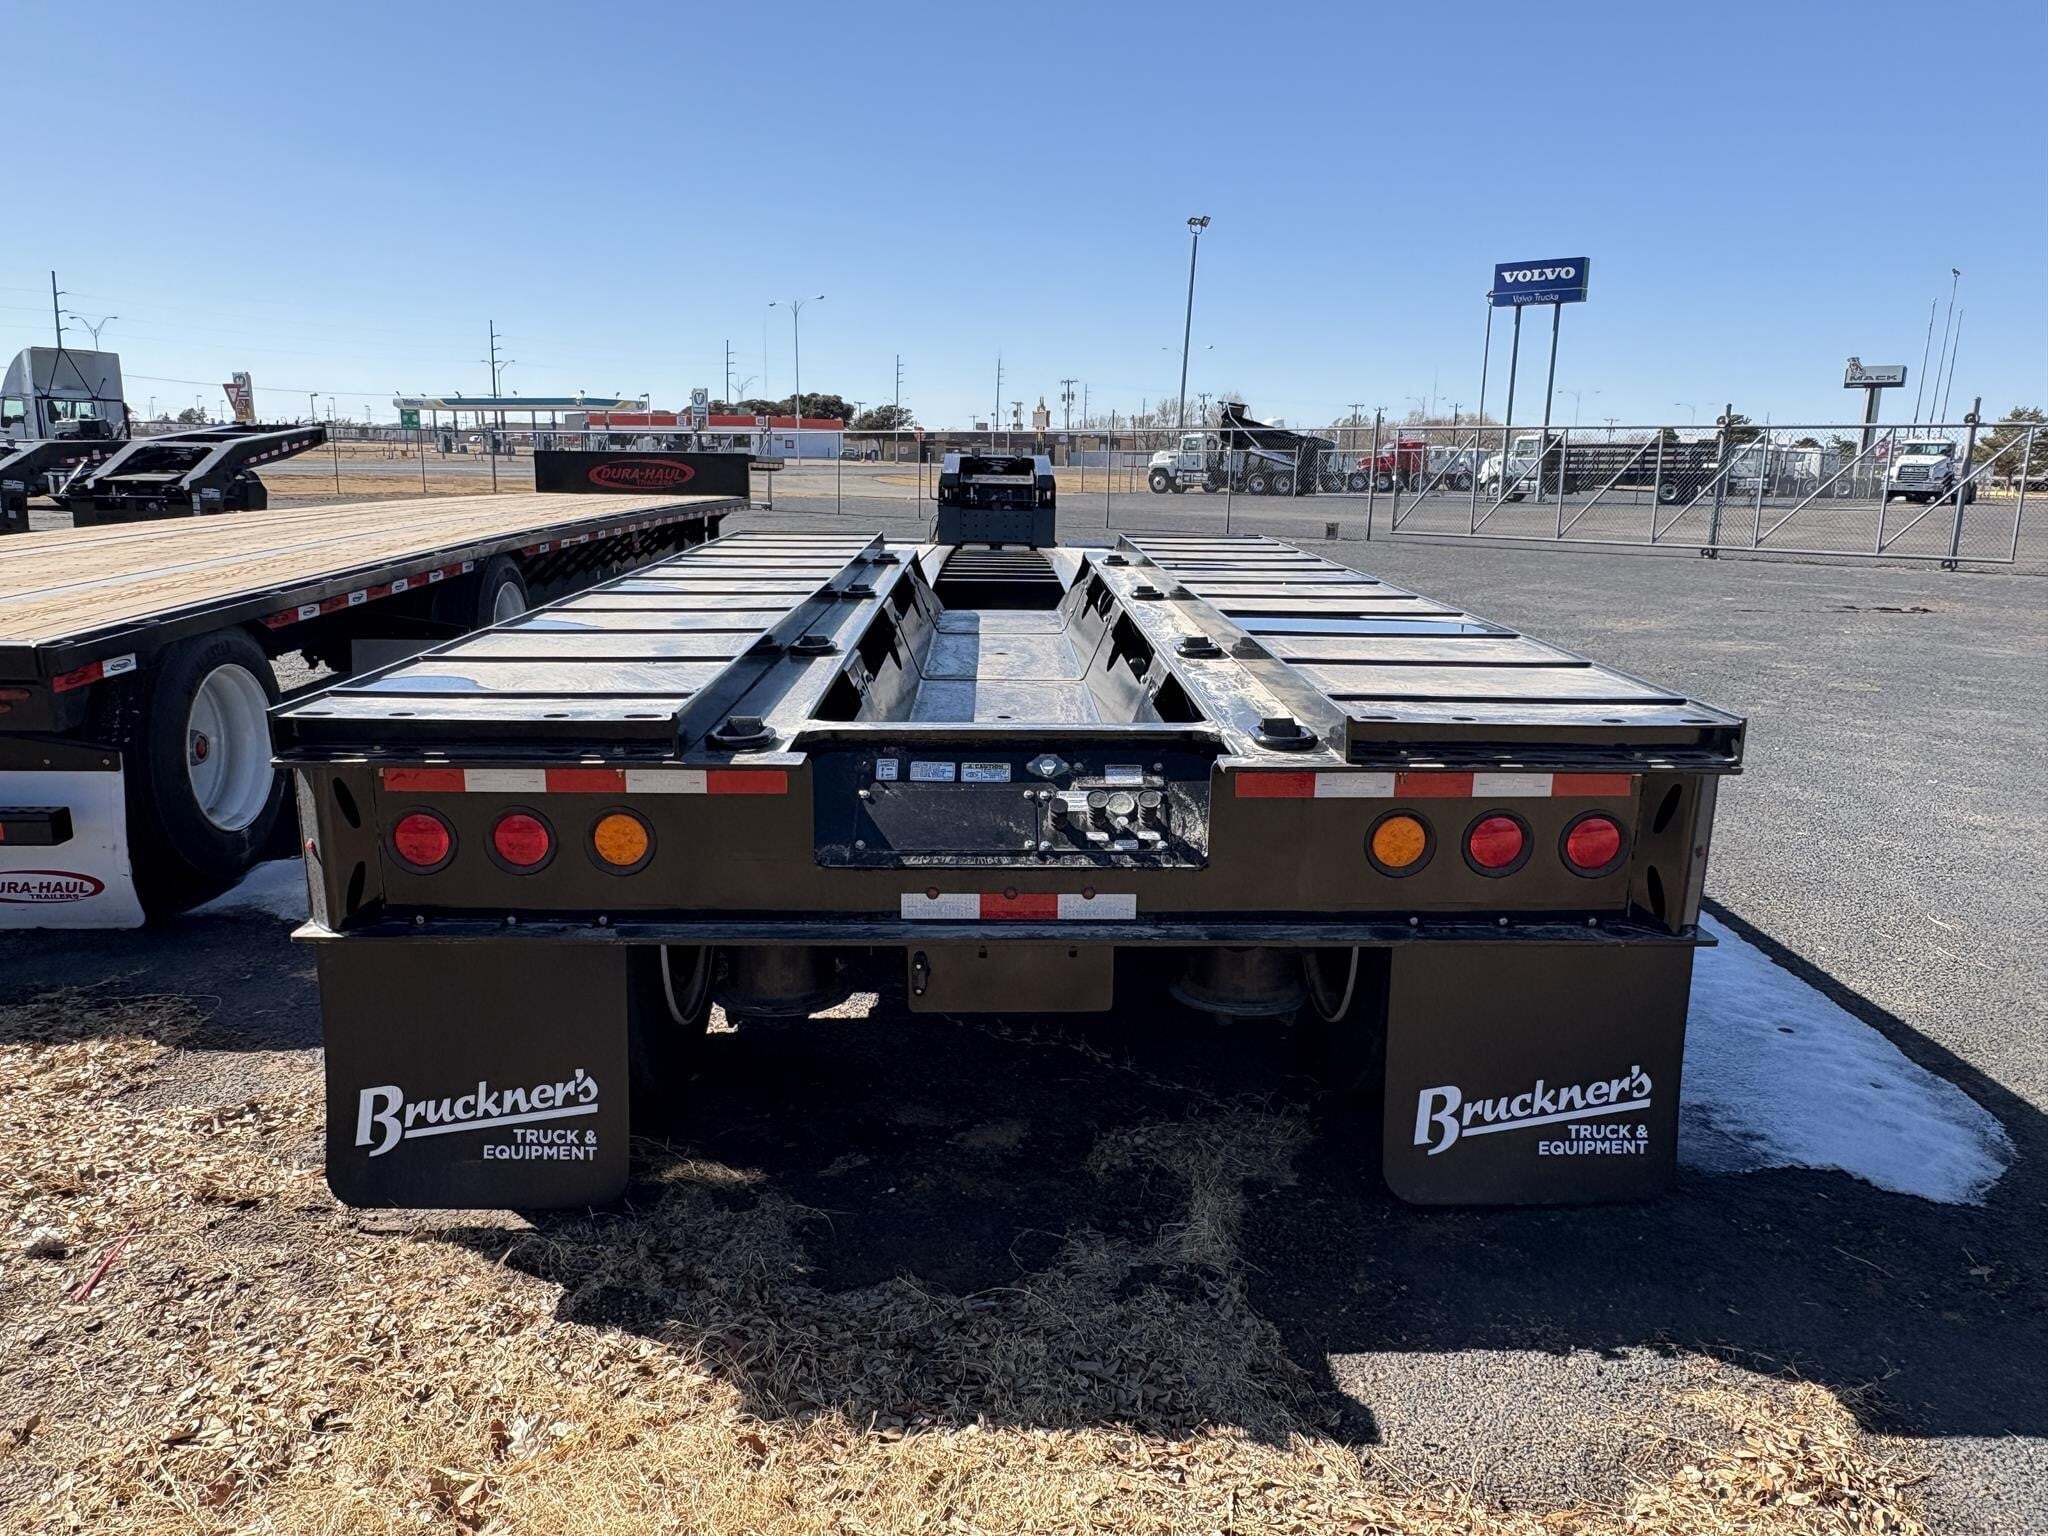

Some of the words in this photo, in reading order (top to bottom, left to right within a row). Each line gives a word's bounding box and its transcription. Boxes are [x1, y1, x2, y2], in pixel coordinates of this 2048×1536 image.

[1502, 267, 1576, 283] VOLVO
[1513, 295, 1533, 303] Volvo
[1534, 293, 1559, 302] Trucks
[601, 466, 681, 480] DURA-HAUL
[355, 1068, 599, 1158] Bruckner's
[1413, 1065, 1653, 1156] Bruckner's
[512, 1128, 579, 1145] TRUCK
[584, 1129, 597, 1145] &
[1567, 1124, 1632, 1140] TRUCK
[1636, 1124, 1649, 1139] &
[483, 1144, 598, 1161] EQUIPMENT
[1538, 1140, 1649, 1156] EQUIPMENT
